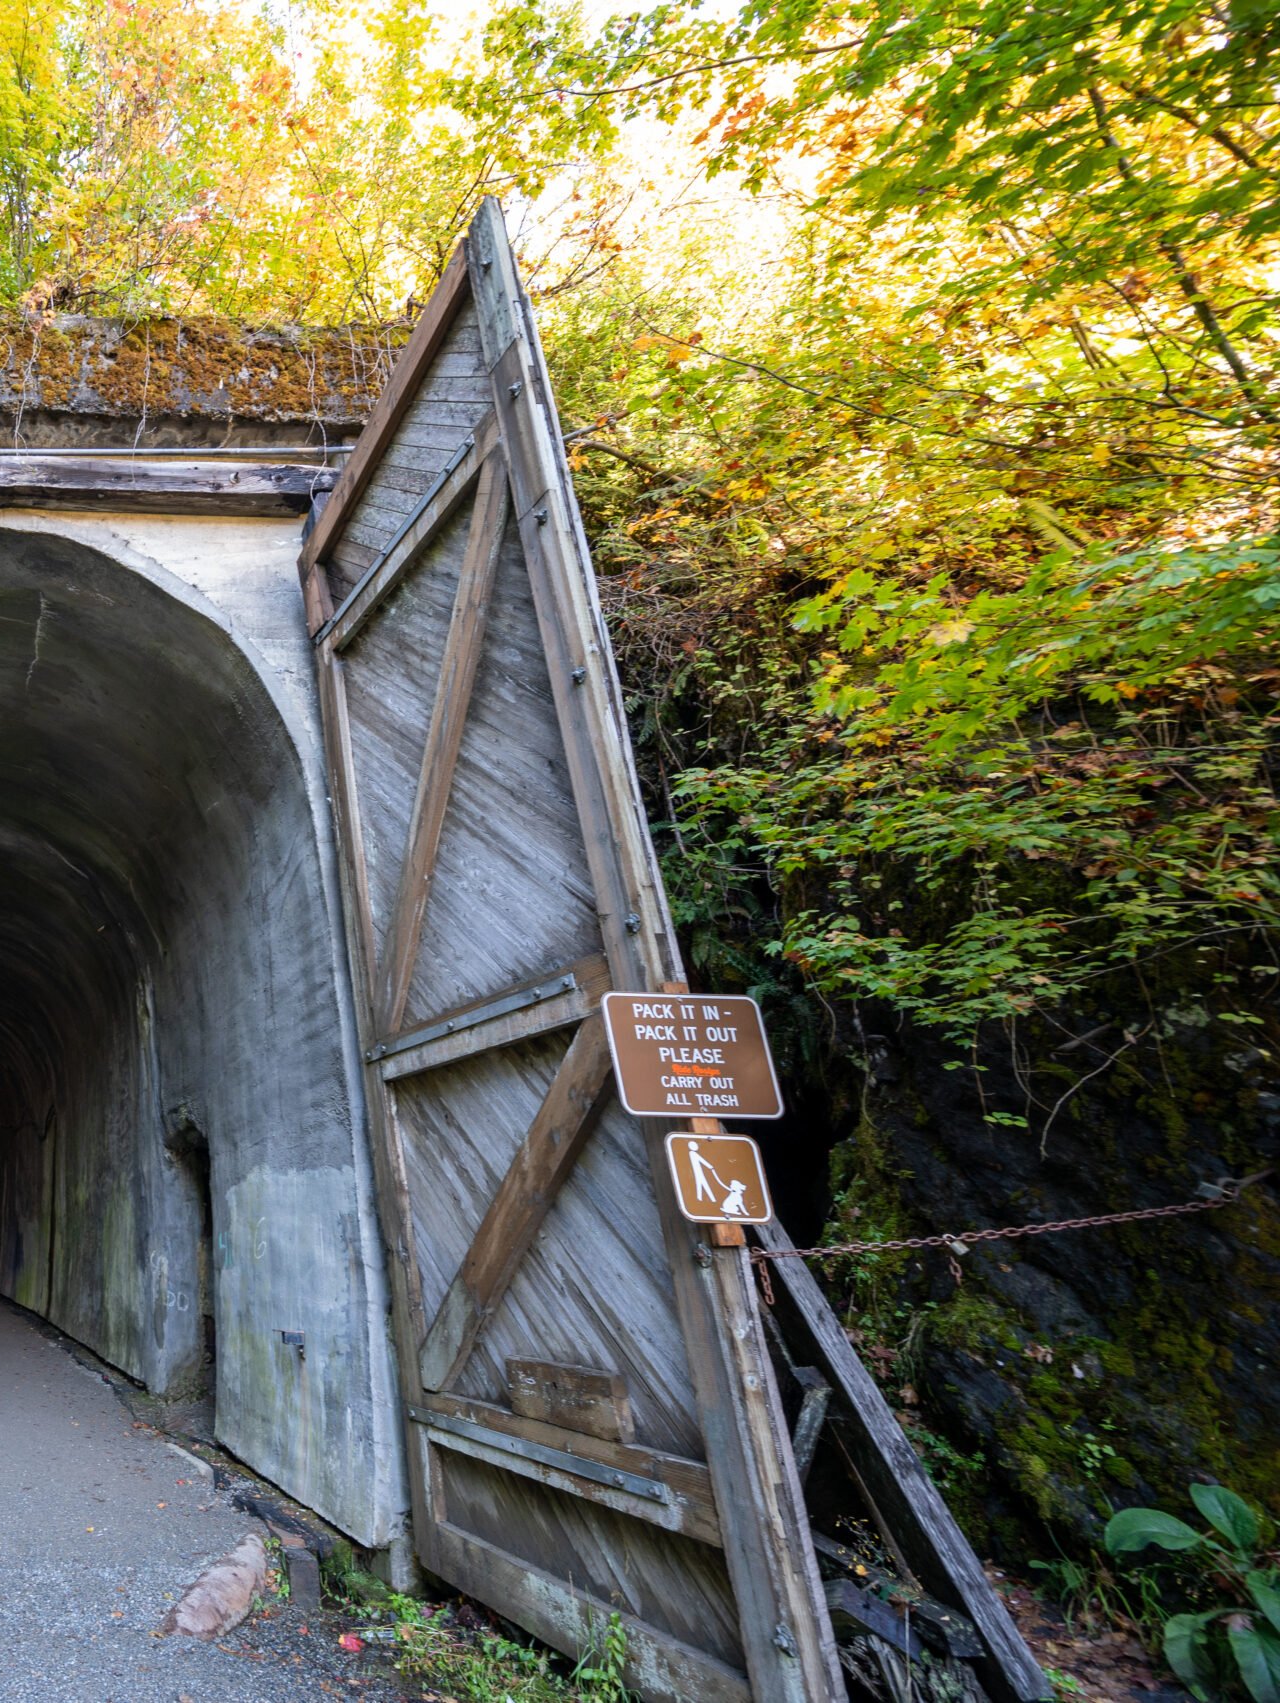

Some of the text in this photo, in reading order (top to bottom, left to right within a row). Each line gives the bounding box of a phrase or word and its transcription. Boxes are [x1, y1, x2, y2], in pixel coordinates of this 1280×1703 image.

[632, 1003, 675, 1019] PACK
[680, 1004, 695, 1020] IT
[702, 1005, 720, 1020] IN
[634, 1024, 737, 1042] PACK IT OUT
[658, 1047, 726, 1064] PLEASE
[661, 1075, 734, 1089] CARRY OUT
[666, 1092, 739, 1107] ALL TRASH
